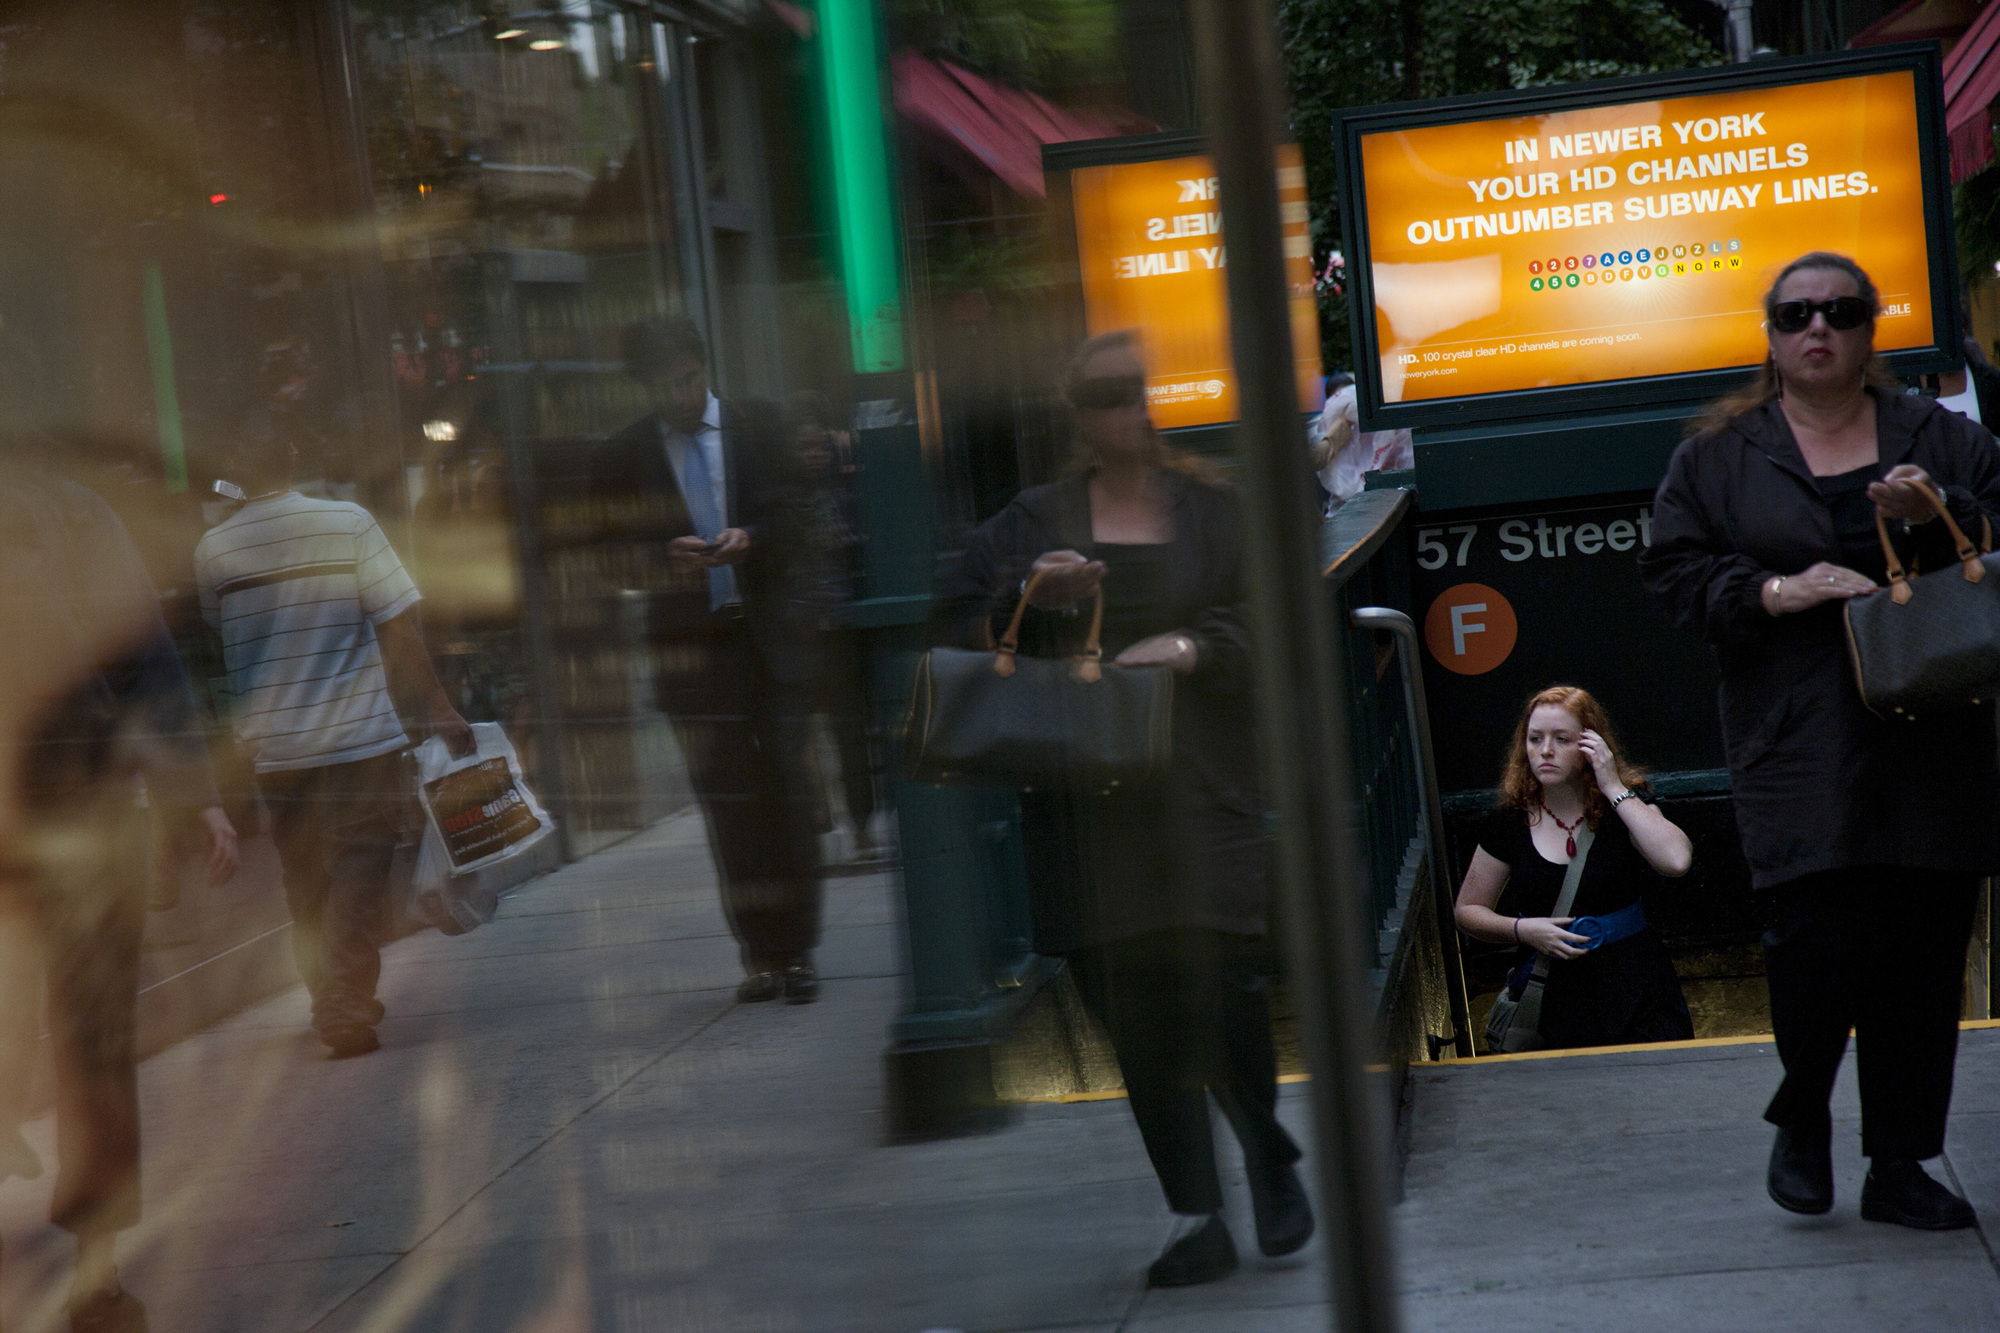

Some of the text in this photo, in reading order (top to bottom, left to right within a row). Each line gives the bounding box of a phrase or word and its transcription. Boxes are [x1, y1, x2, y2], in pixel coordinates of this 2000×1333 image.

[1505, 112, 1766, 164] IN NEWER YORK
[1467, 143, 1809, 202] YOUR HD CHANNELS
[1407, 171, 1878, 245] OUTNUMBER SUBWAY LINES.
[1881, 303, 1911, 315] ABLE
[1398, 333, 1641, 365] HD. 100 crystal clear HD channels are coming soon.
[1399, 367, 1457, 379] neweryork.com
[1416, 508, 1653, 570] 57 Street
[1451, 603, 1487, 655] F
